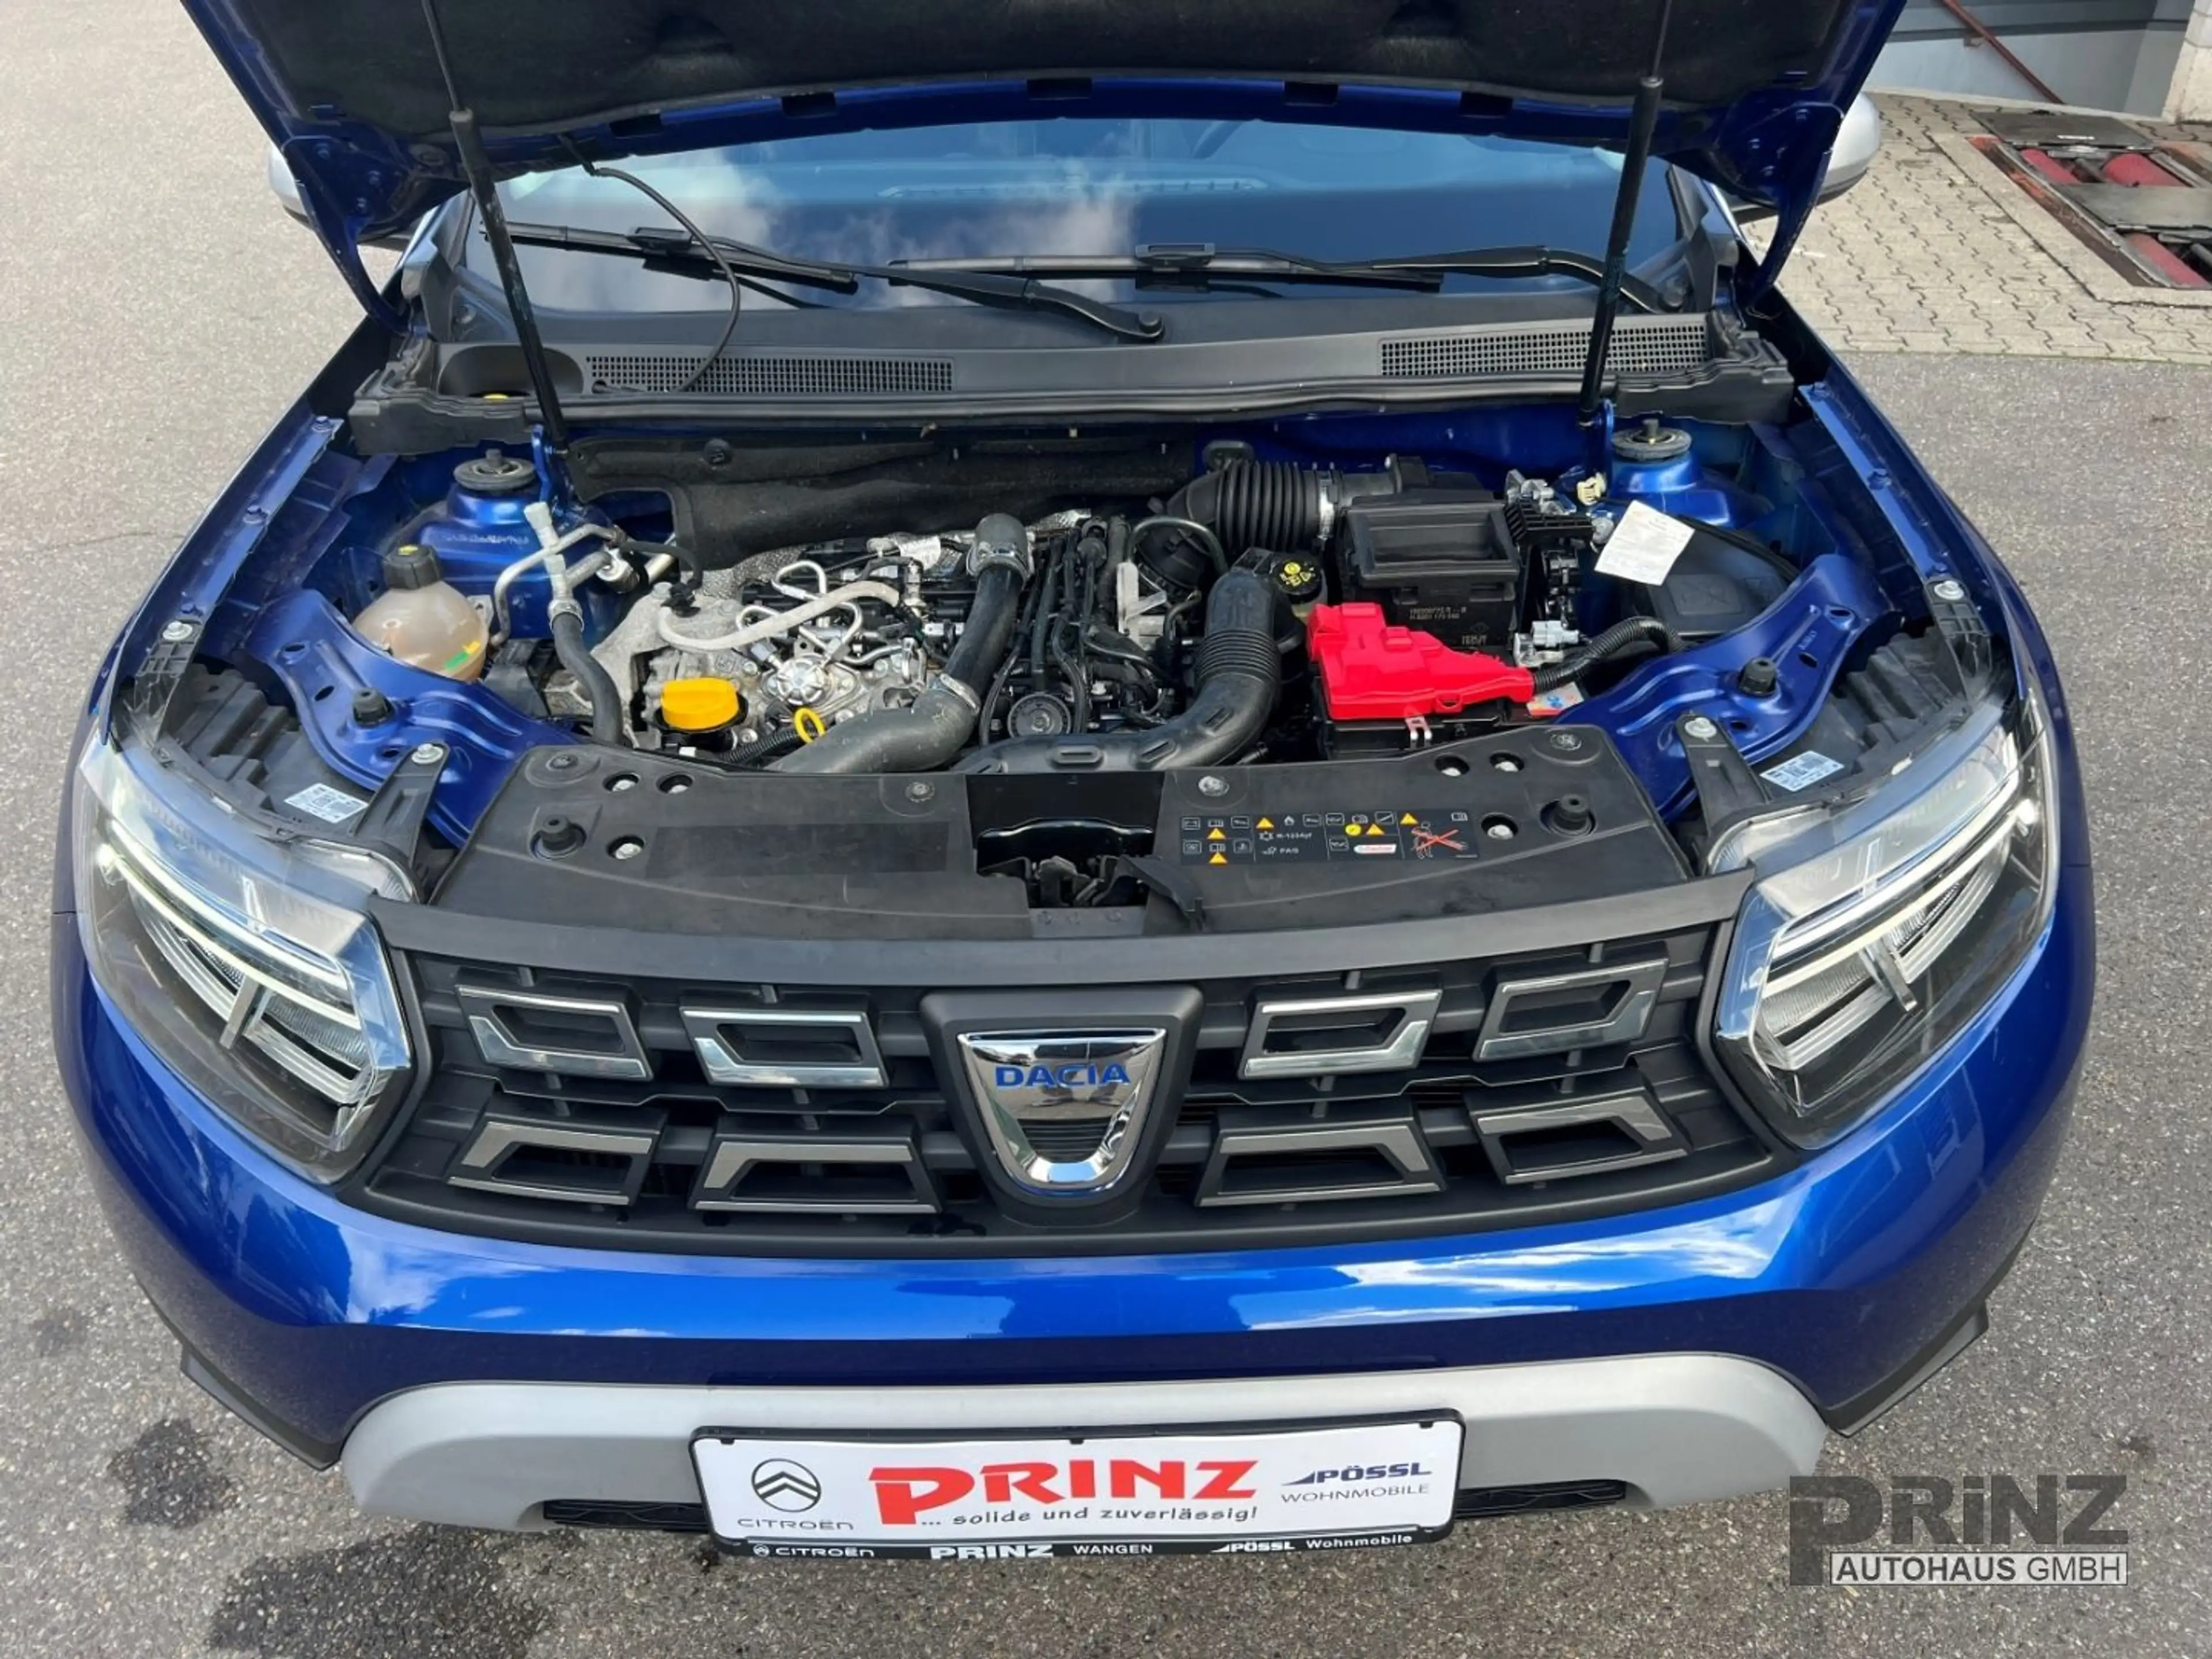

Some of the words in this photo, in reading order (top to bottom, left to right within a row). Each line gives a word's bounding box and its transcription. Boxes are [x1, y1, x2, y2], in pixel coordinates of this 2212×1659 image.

[995, 1063, 1131, 1088] DACIA
[1316, 1462, 1433, 1484] PÖSSL
[869, 1459, 1258, 1525] PRINZ
[1281, 1483, 1429, 1503] WOHNMOBILE
[953, 1510, 1031, 1525] solide
[1043, 1507, 1088, 1520] und
[1100, 1506, 1257, 1522] zuverlässig!
[930, 1544, 1054, 1559] PRINZ
[1073, 1544, 1153, 1554] WANGEN
[1230, 1541, 1295, 1553] PÖSSL
[1305, 1534, 1412, 1550] Wohnmobile
